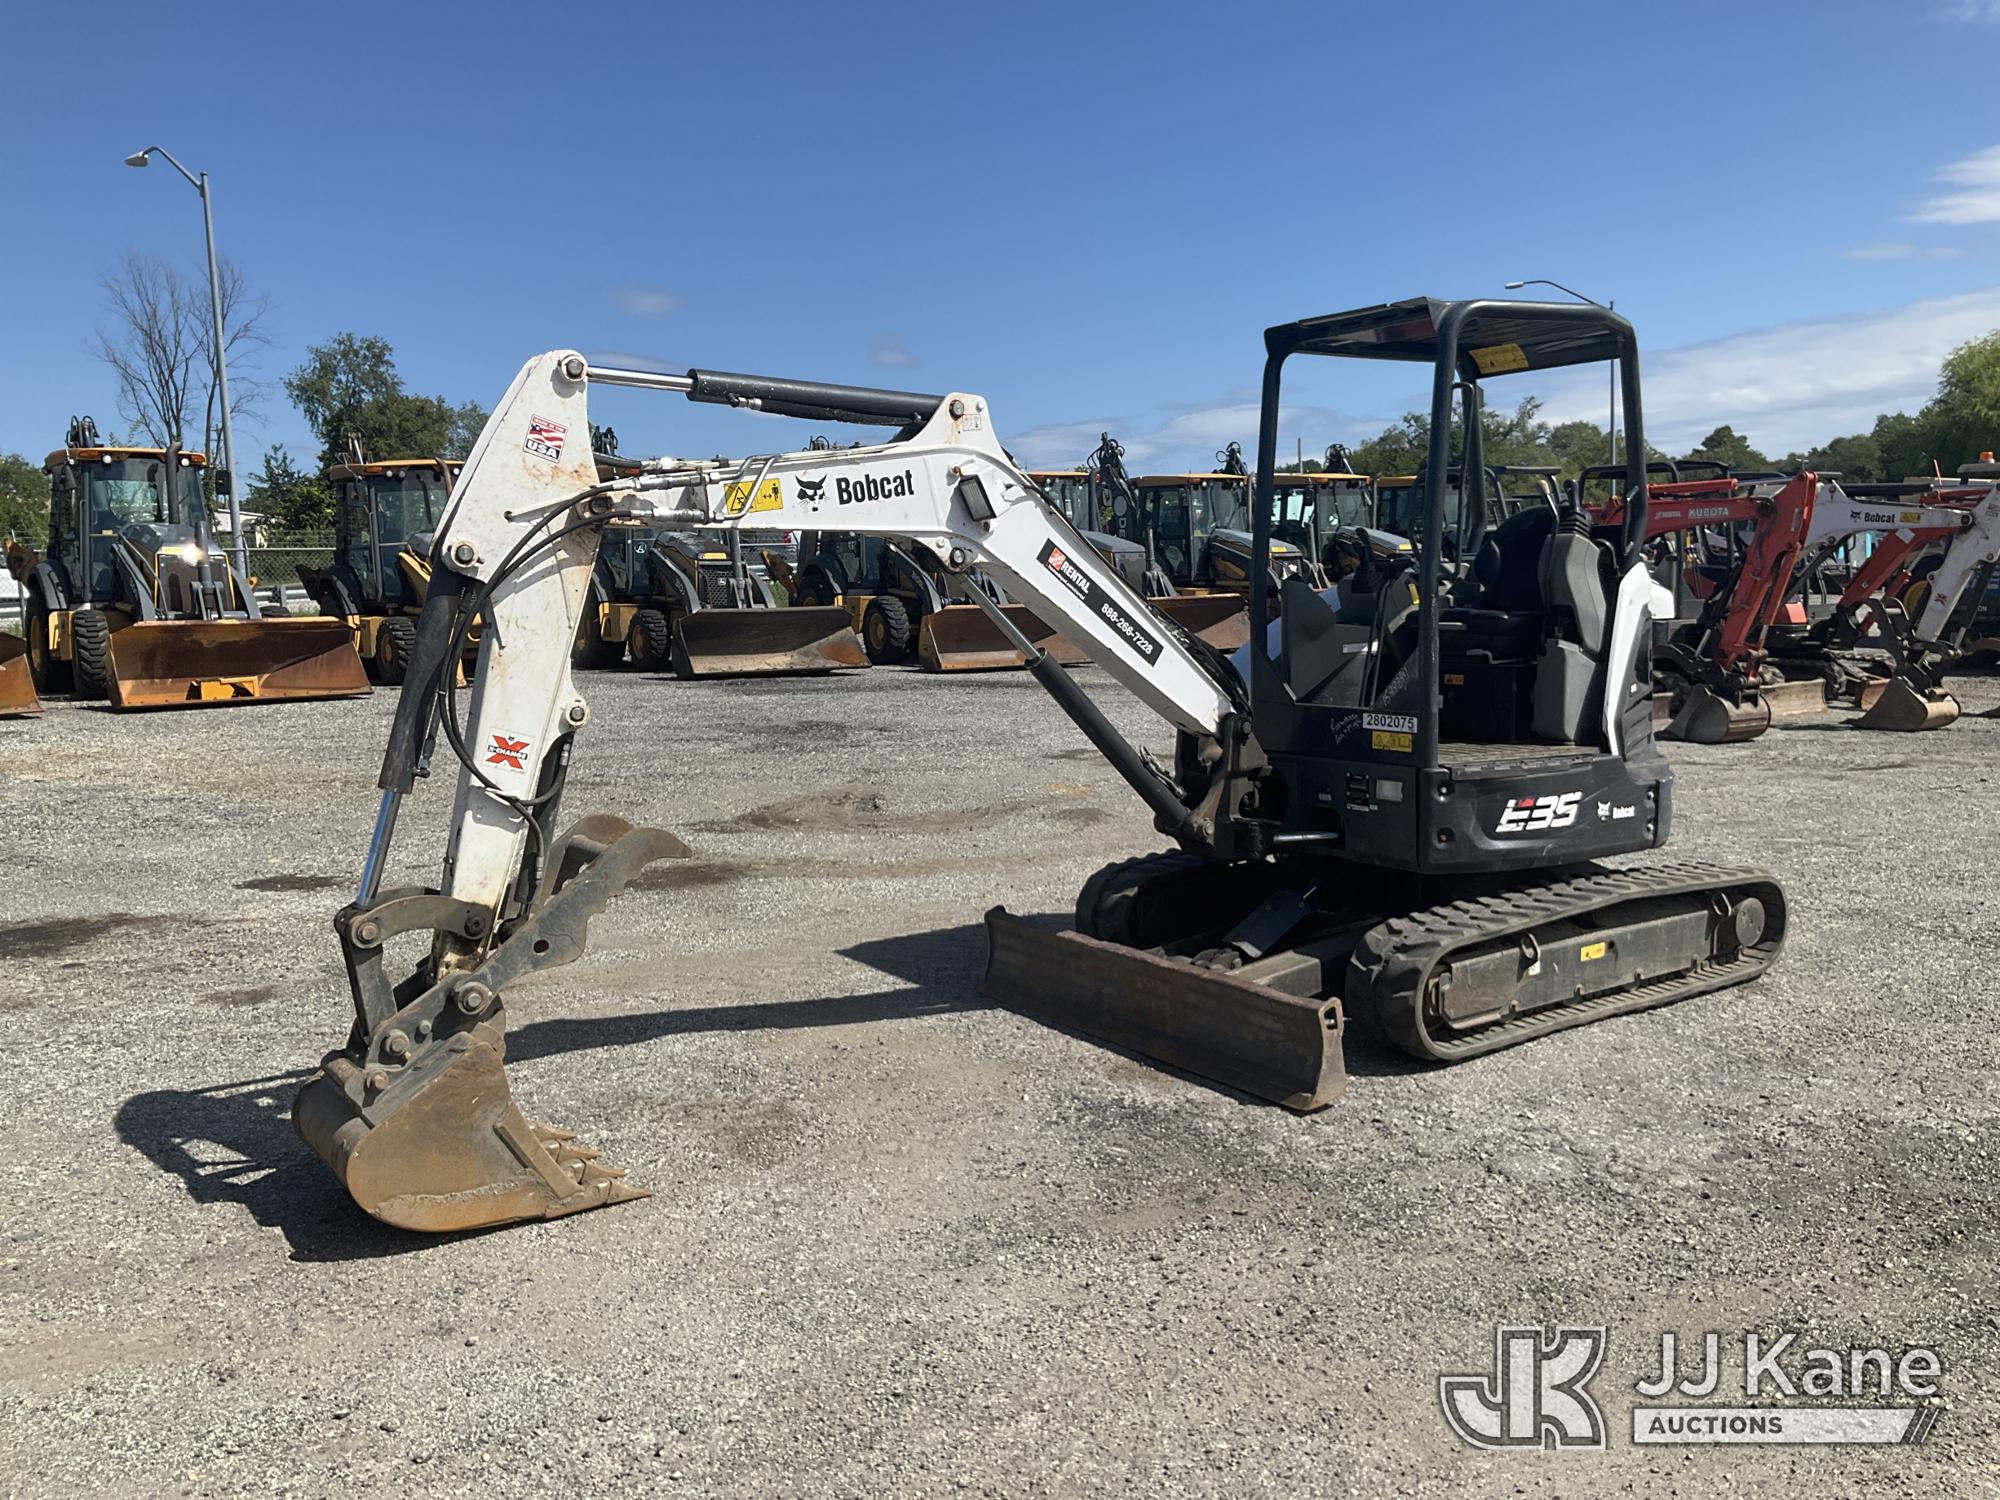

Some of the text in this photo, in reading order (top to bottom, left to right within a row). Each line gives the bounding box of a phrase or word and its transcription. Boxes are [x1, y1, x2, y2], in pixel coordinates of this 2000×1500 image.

[526, 440, 558, 459] USA
[835, 469, 915, 505] Bobcat
[1689, 507, 1729, 518] KUBOTA
[1864, 512, 1896, 523] Bobcat
[1060, 561, 1090, 594] RENTAL
[1101, 603, 1153, 654] 888-266-7228
[1366, 714, 1414, 729] 2802075
[1495, 791, 1583, 833] E35
